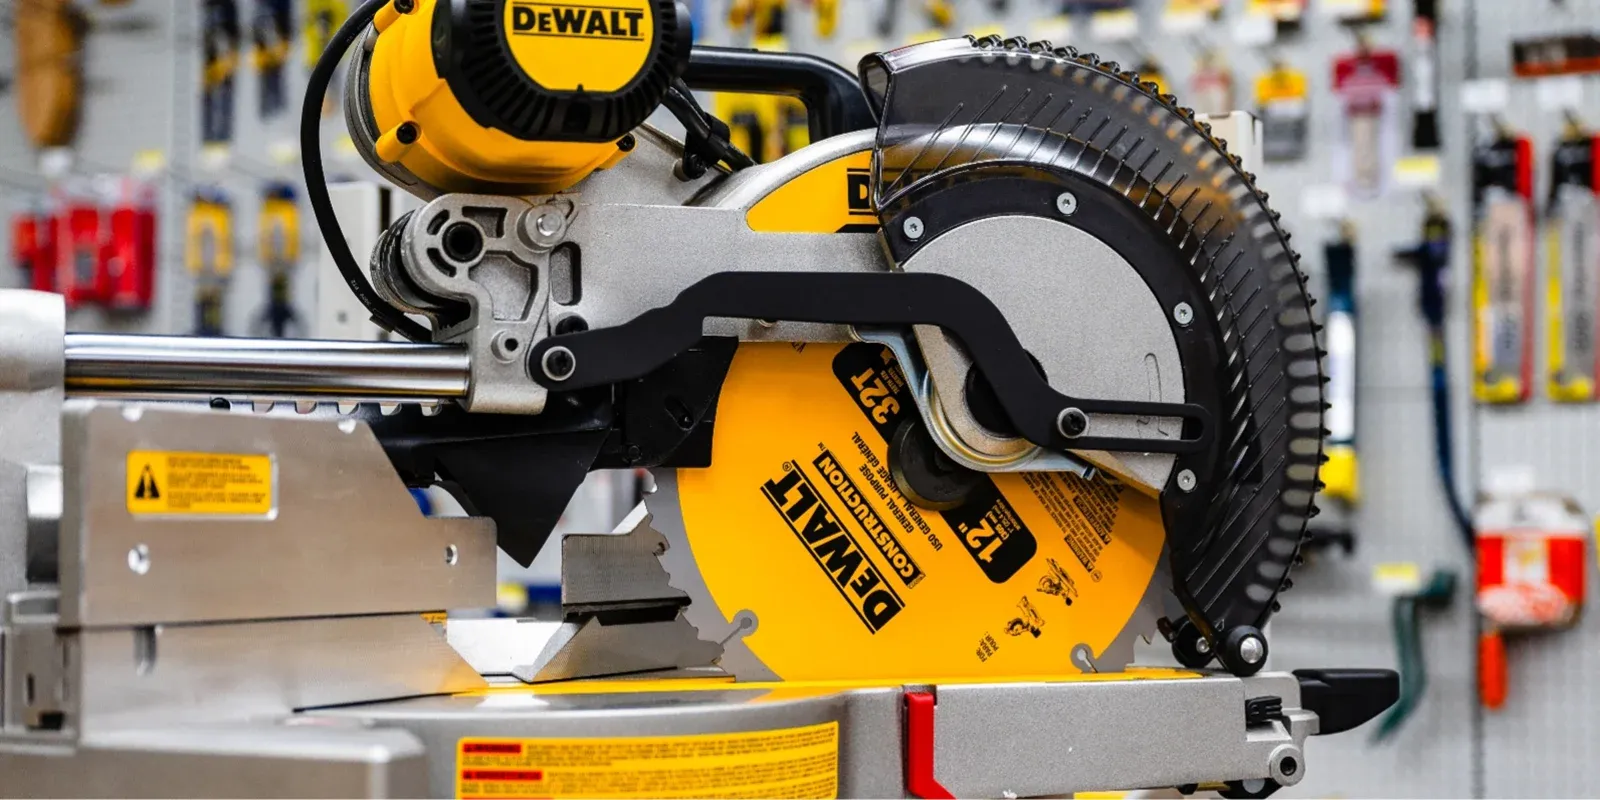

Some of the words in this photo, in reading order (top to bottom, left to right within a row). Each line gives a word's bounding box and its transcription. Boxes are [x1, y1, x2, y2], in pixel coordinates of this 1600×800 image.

[513, 6, 643, 37] DEWALT
[849, 366, 900, 424] 32T
[858, 462, 890, 500] PURPOSE
[818, 455, 916, 578] CONSTRUCTION
[884, 497, 916, 534] GENERAL
[926, 532, 944, 551] USO
